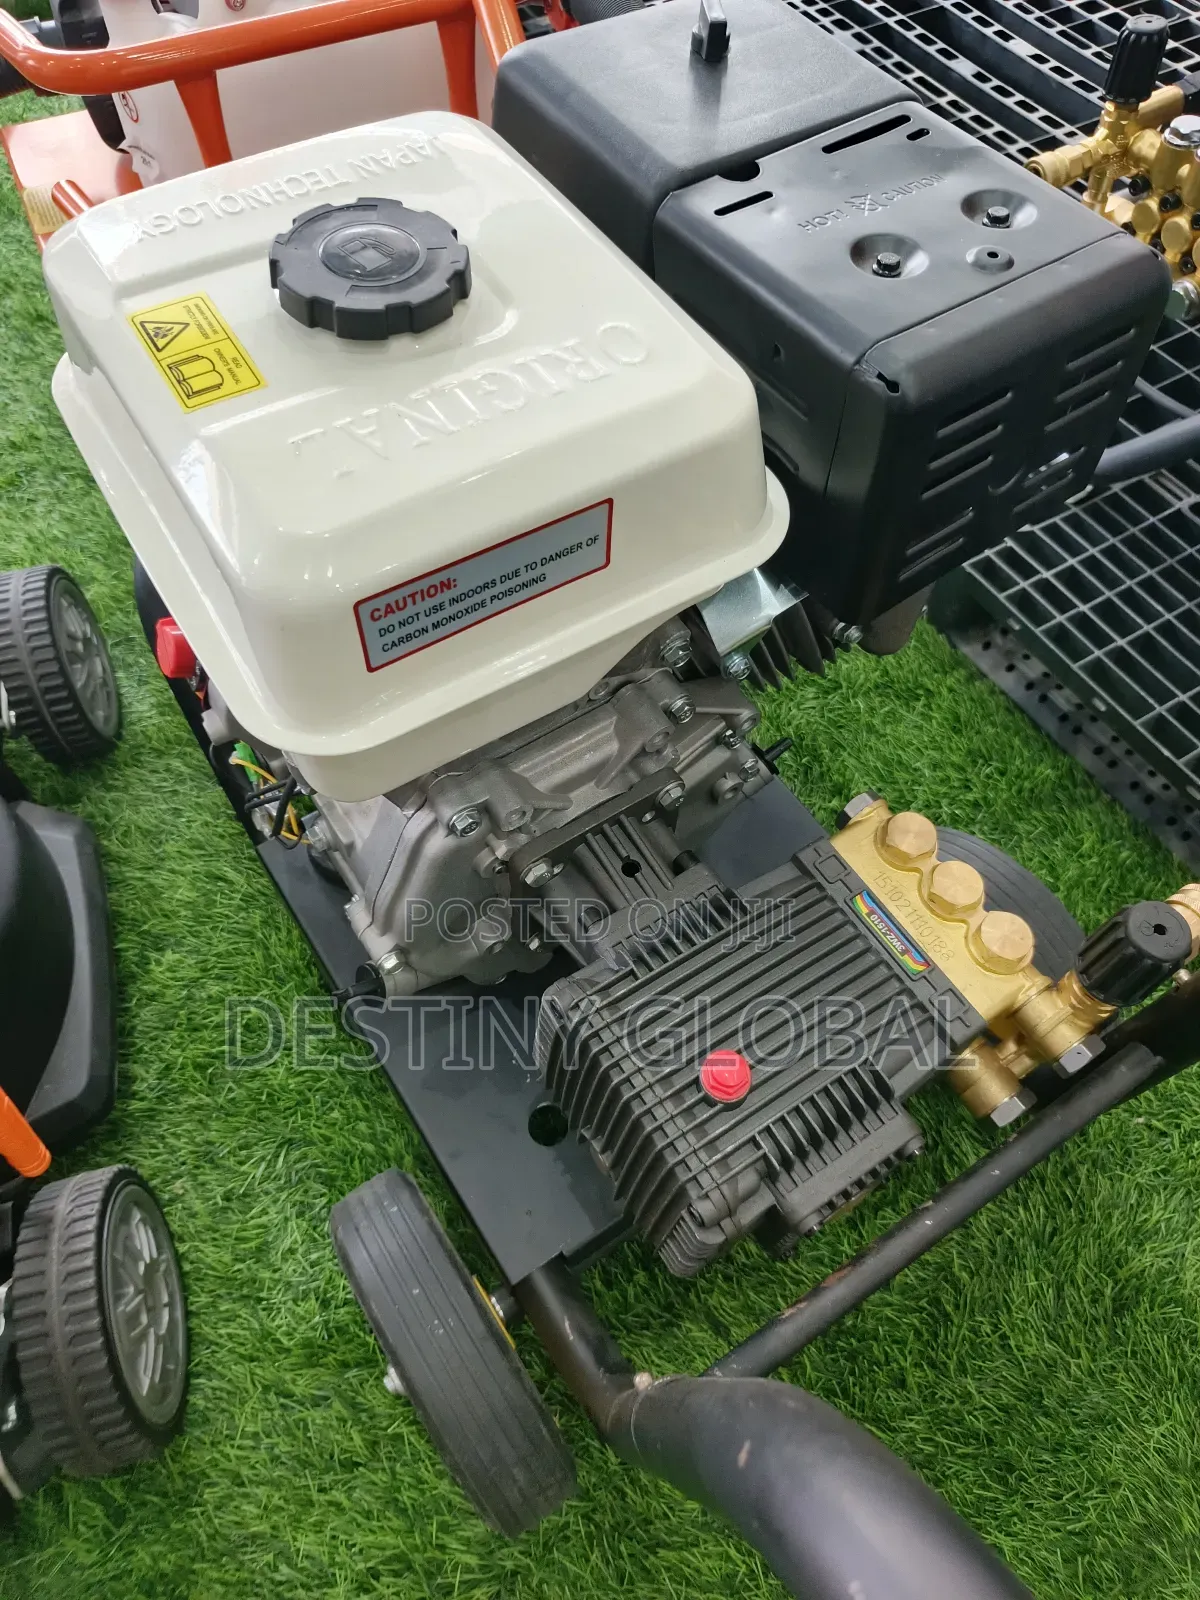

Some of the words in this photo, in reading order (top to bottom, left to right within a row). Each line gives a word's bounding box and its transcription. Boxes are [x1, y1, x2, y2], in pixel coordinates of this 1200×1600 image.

[348, 135, 443, 177] JAPAN
[137, 164, 353, 240] TECHNOLOGY
[797, 208, 850, 233] HOT!
[881, 173, 948, 201] CAUTION
[287, 322, 650, 477] ORIGINAL
[369, 577, 457, 622] CAUTION:
[379, 624, 395, 638] DO
[398, 613, 421, 630] NOT
[424, 602, 446, 618] USE
[449, 579, 497, 607] INDOORS
[500, 568, 521, 584] DUE
[524, 561, 538, 574] TO
[540, 541, 583, 567] DANGER
[586, 534, 600, 547] OF
[382, 627, 429, 653] CARBON
[432, 602, 488, 631] MONOXIDE
[490, 573, 547, 605] POISONING
[870, 914, 906, 952] 3WZ-1510
